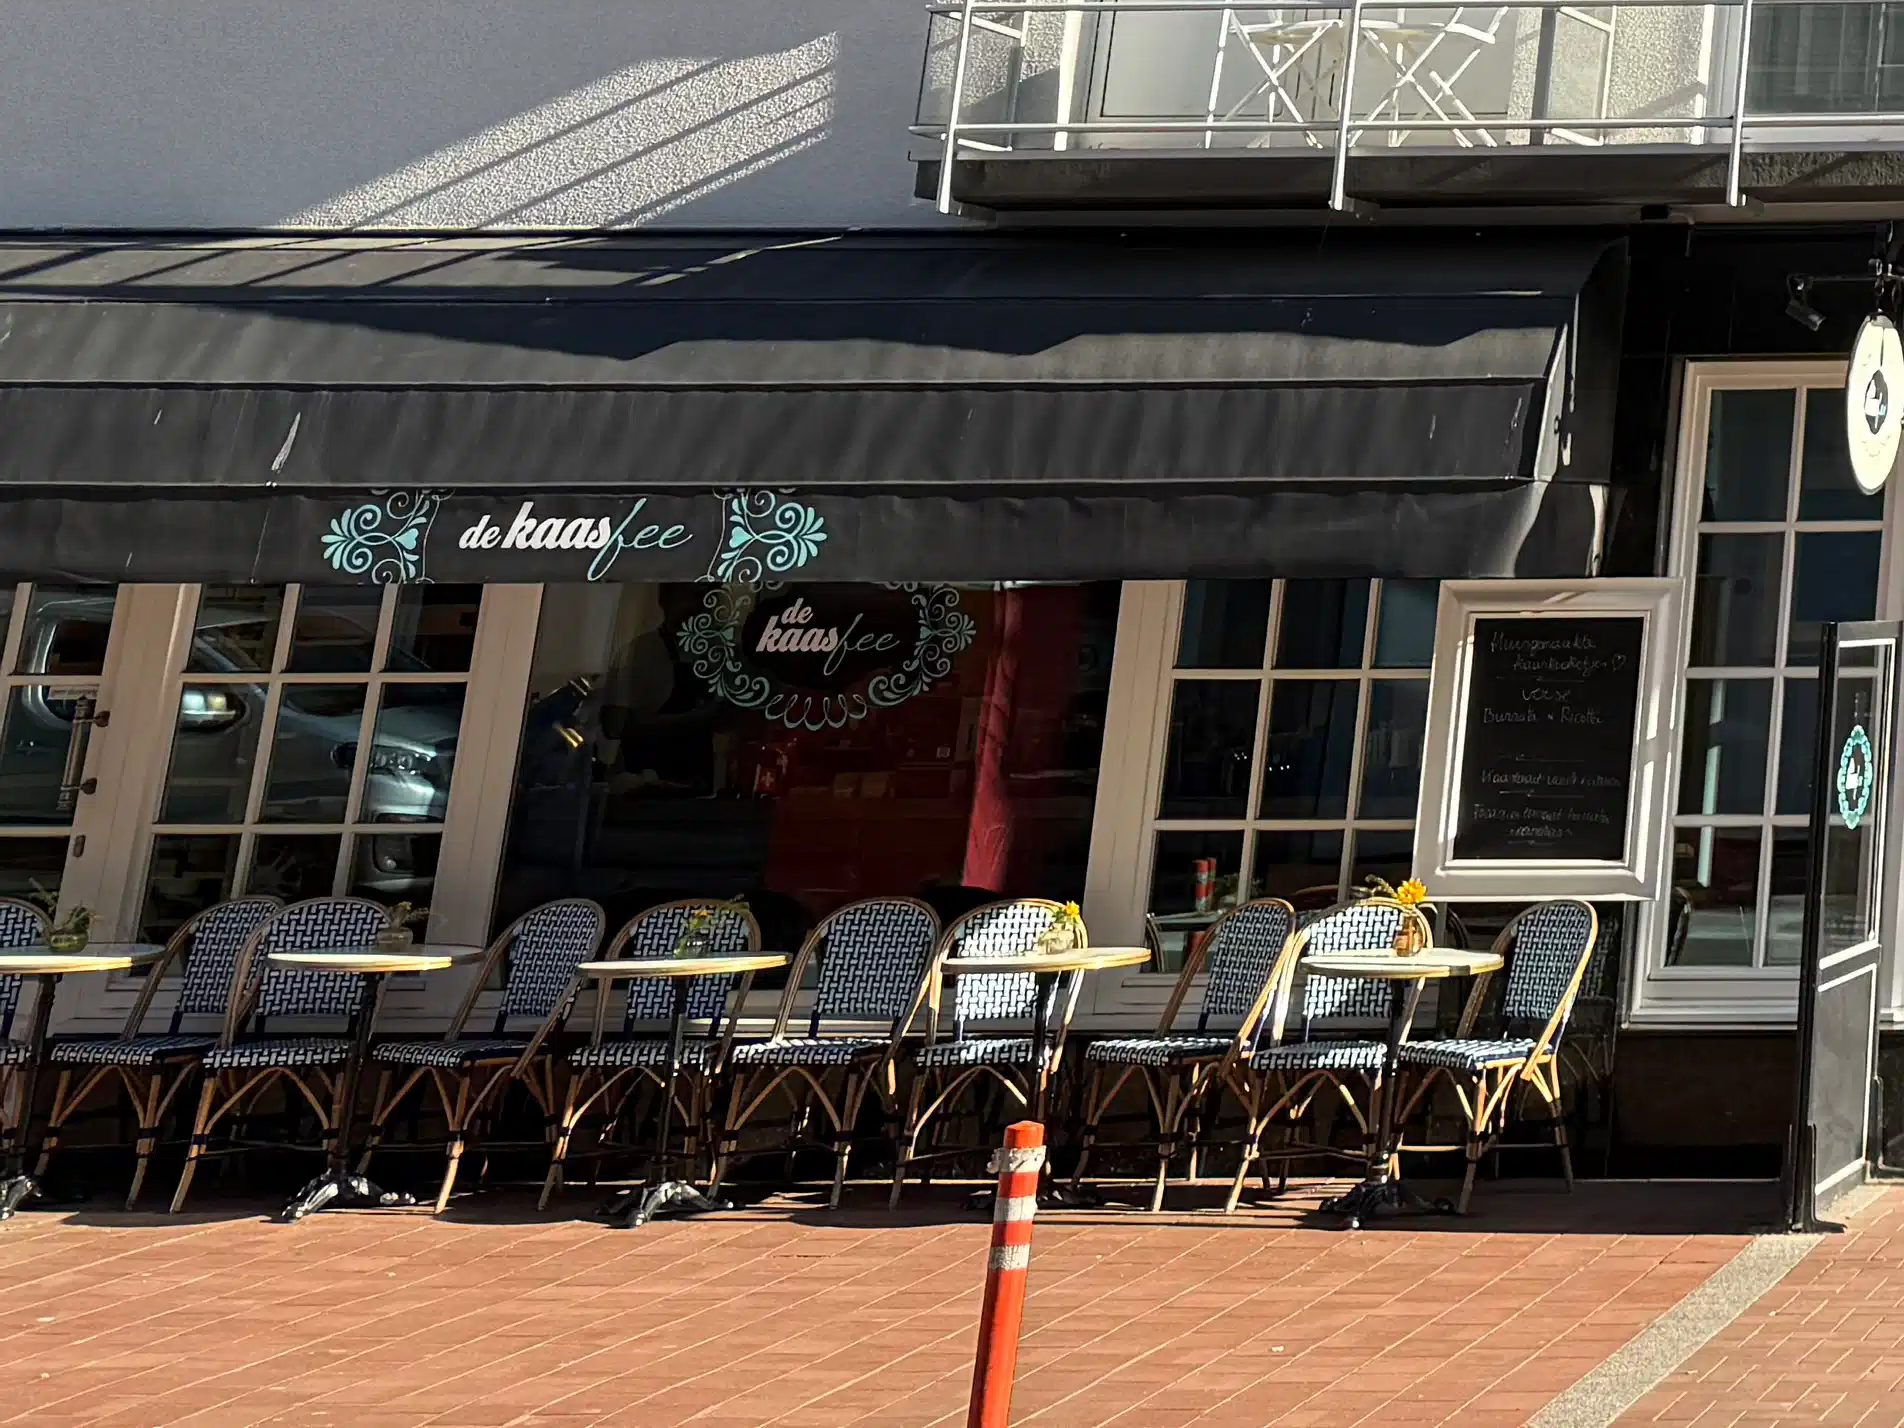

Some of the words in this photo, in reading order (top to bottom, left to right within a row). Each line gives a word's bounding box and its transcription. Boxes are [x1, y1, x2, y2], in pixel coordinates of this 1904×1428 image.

[458, 513, 502, 549] de
[503, 497, 693, 582] kaasfee
[781, 597, 814, 624] de
[756, 612, 901, 676] kaasfee
